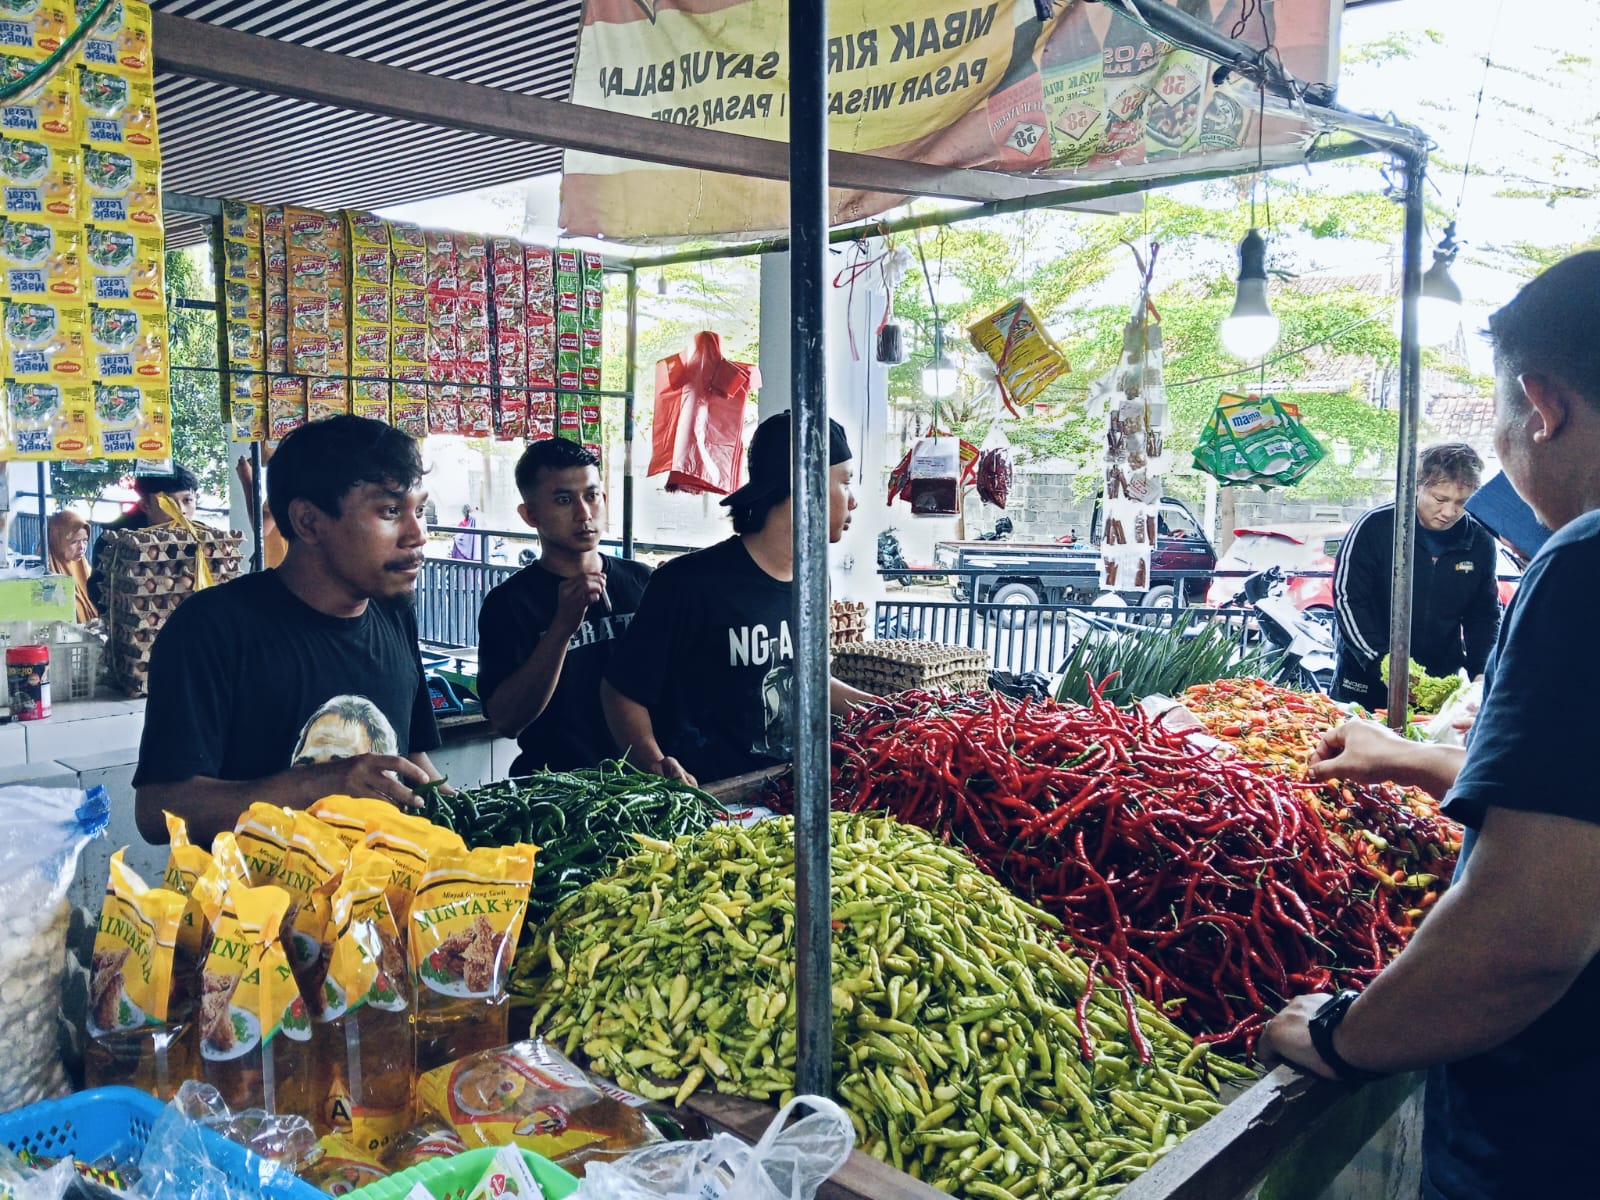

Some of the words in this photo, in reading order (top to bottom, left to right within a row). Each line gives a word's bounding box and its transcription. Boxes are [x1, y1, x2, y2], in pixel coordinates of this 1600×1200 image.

[86, 50, 117, 64] Magic
[4, 106, 34, 119] Lezat
[3, 117, 37, 130] Magic
[91, 119, 118, 131] Lezat
[90, 129, 122, 142] Magic
[8, 190, 38, 201] Lezat
[7, 199, 42, 212] Magic
[95, 199, 123, 210] Lezat
[93, 209, 126, 222] Magic
[10, 280, 46, 294] Magic
[97, 287, 129, 299] Magic
[101, 355, 130, 365] Lezat
[14, 361, 49, 374] Magic
[101, 363, 134, 377] Magic
[1232, 410, 1261, 427] mama
[104, 432, 132, 442] Lezat
[103, 441, 135, 454] Magic
